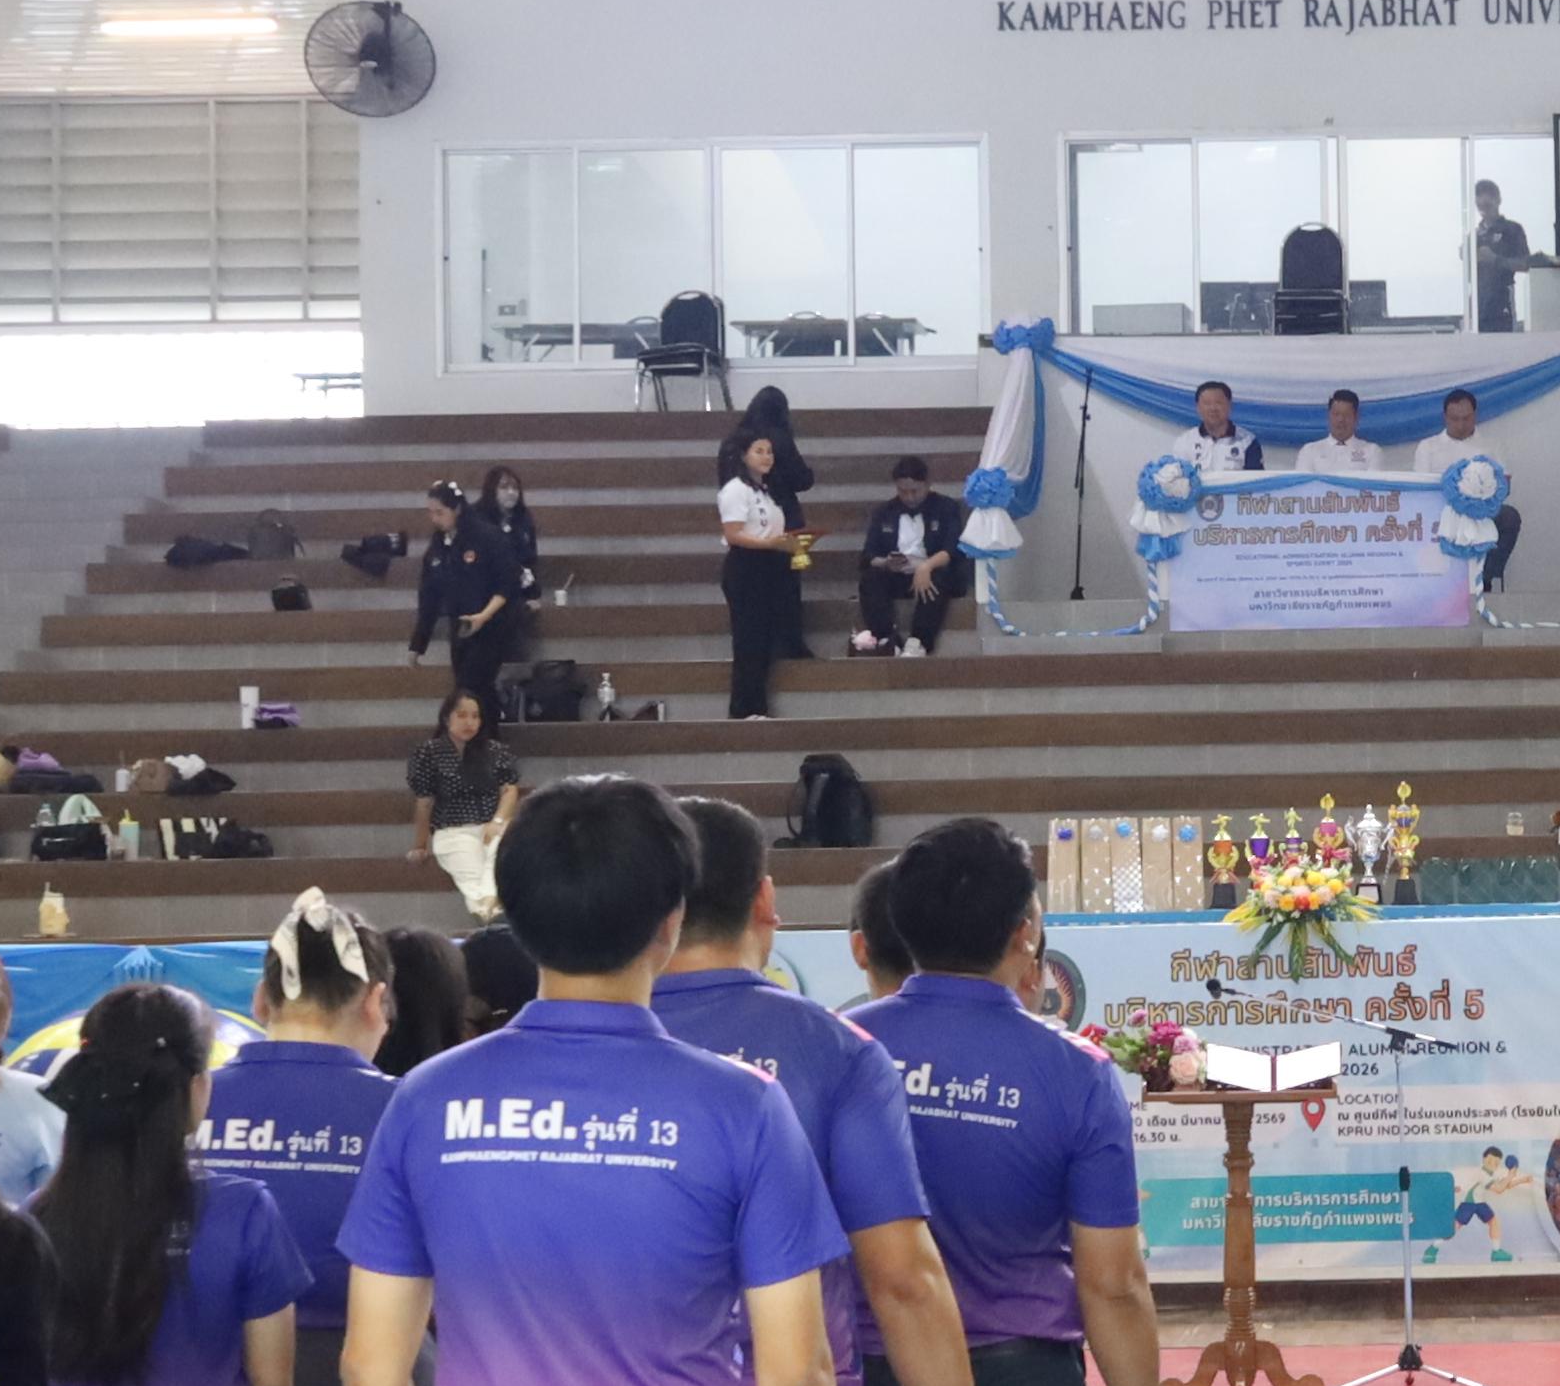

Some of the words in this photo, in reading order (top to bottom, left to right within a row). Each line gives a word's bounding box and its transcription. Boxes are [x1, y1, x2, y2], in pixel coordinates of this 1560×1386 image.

[996, 0, 1187, 32] KAMPHAENG
[1207, 0, 1283, 30] PHET
[1365, 979, 1452, 1021] ครั้งที่
[1463, 990, 1485, 1020] 5
[1495, 1041, 1507, 1054] &
[1342, 1063, 1379, 1076] 2026
[945, 1073, 989, 1107] รุ่นที่
[997, 1086, 1021, 1108] 13
[445, 1098, 577, 1140] M.Ed.
[582, 1107, 638, 1151] รุ่นที่
[648, 1120, 678, 1146] 13
[1255, 1113, 1286, 1124] 2569
[1338, 1125, 1373, 1136] KPRU
[1434, 1123, 1494, 1135] STADIUM
[287, 1125, 331, 1160] รุ่นที่
[339, 1135, 362, 1156] 13
[605, 1154, 677, 1170] UNIVERSITY
